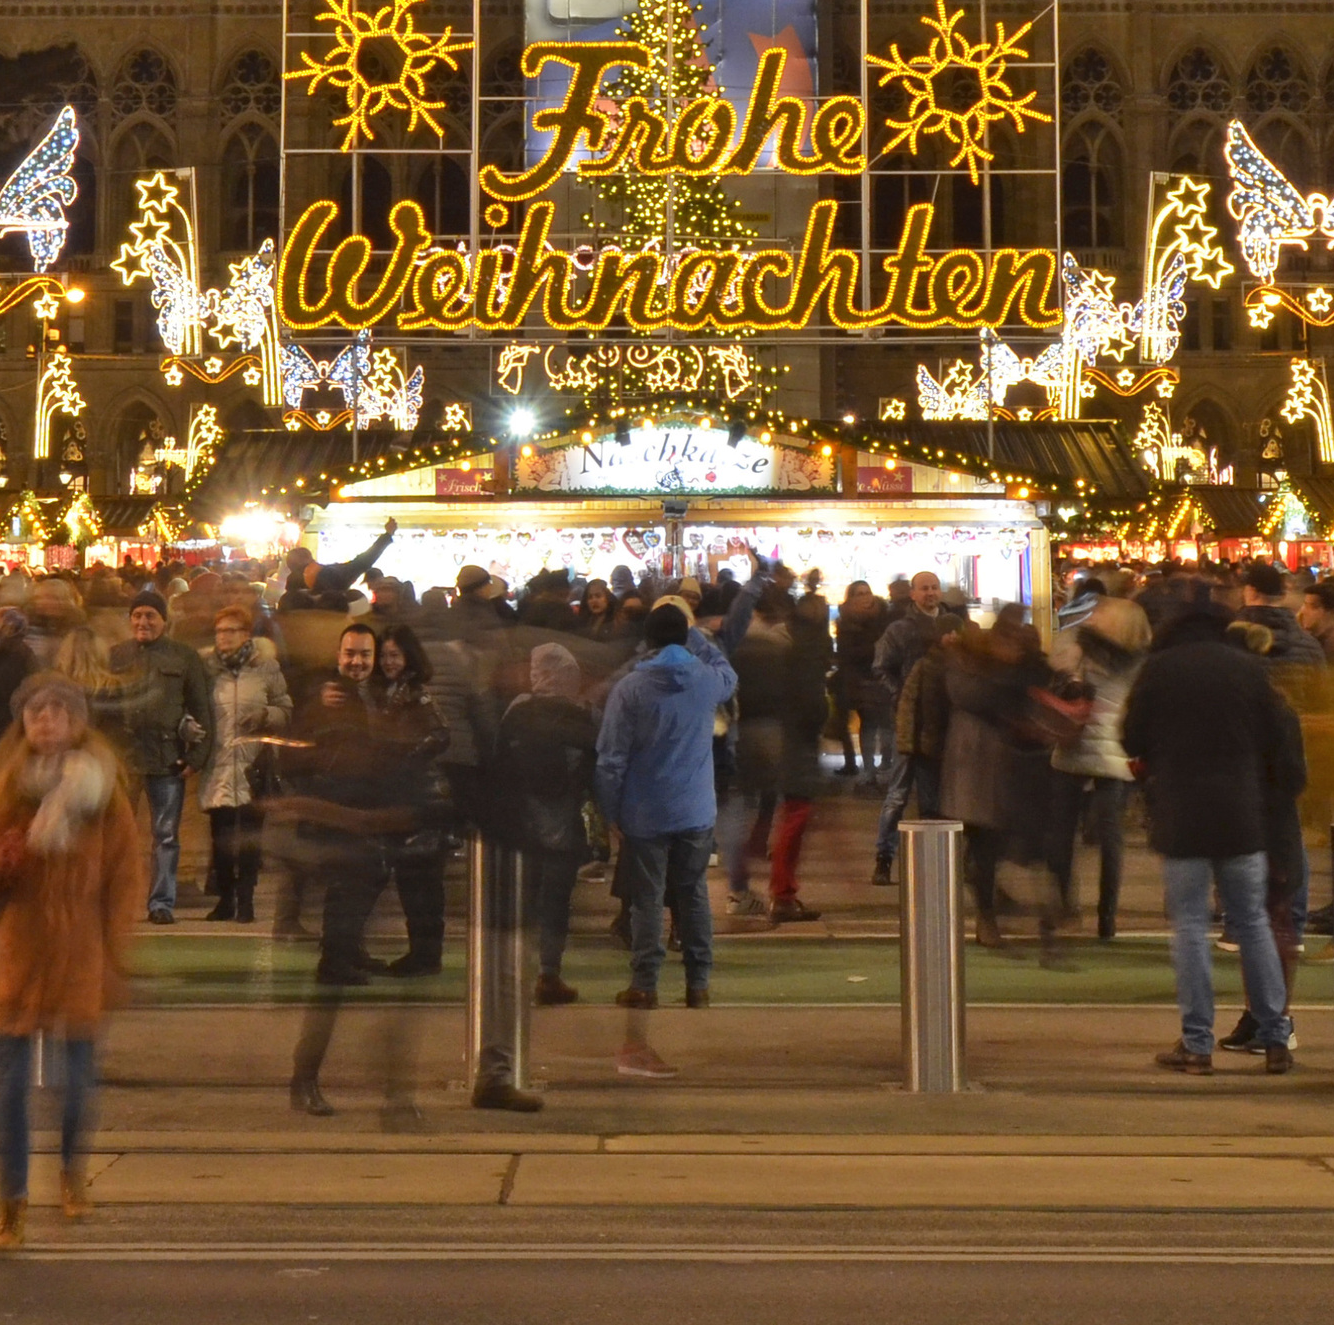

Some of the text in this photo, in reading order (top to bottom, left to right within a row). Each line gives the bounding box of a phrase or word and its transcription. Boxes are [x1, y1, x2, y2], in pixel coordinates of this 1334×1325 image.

[479, 39, 868, 202] Frohe
[276, 198, 1065, 332] Weihnachten
[579, 432, 770, 475] Nachkaze
